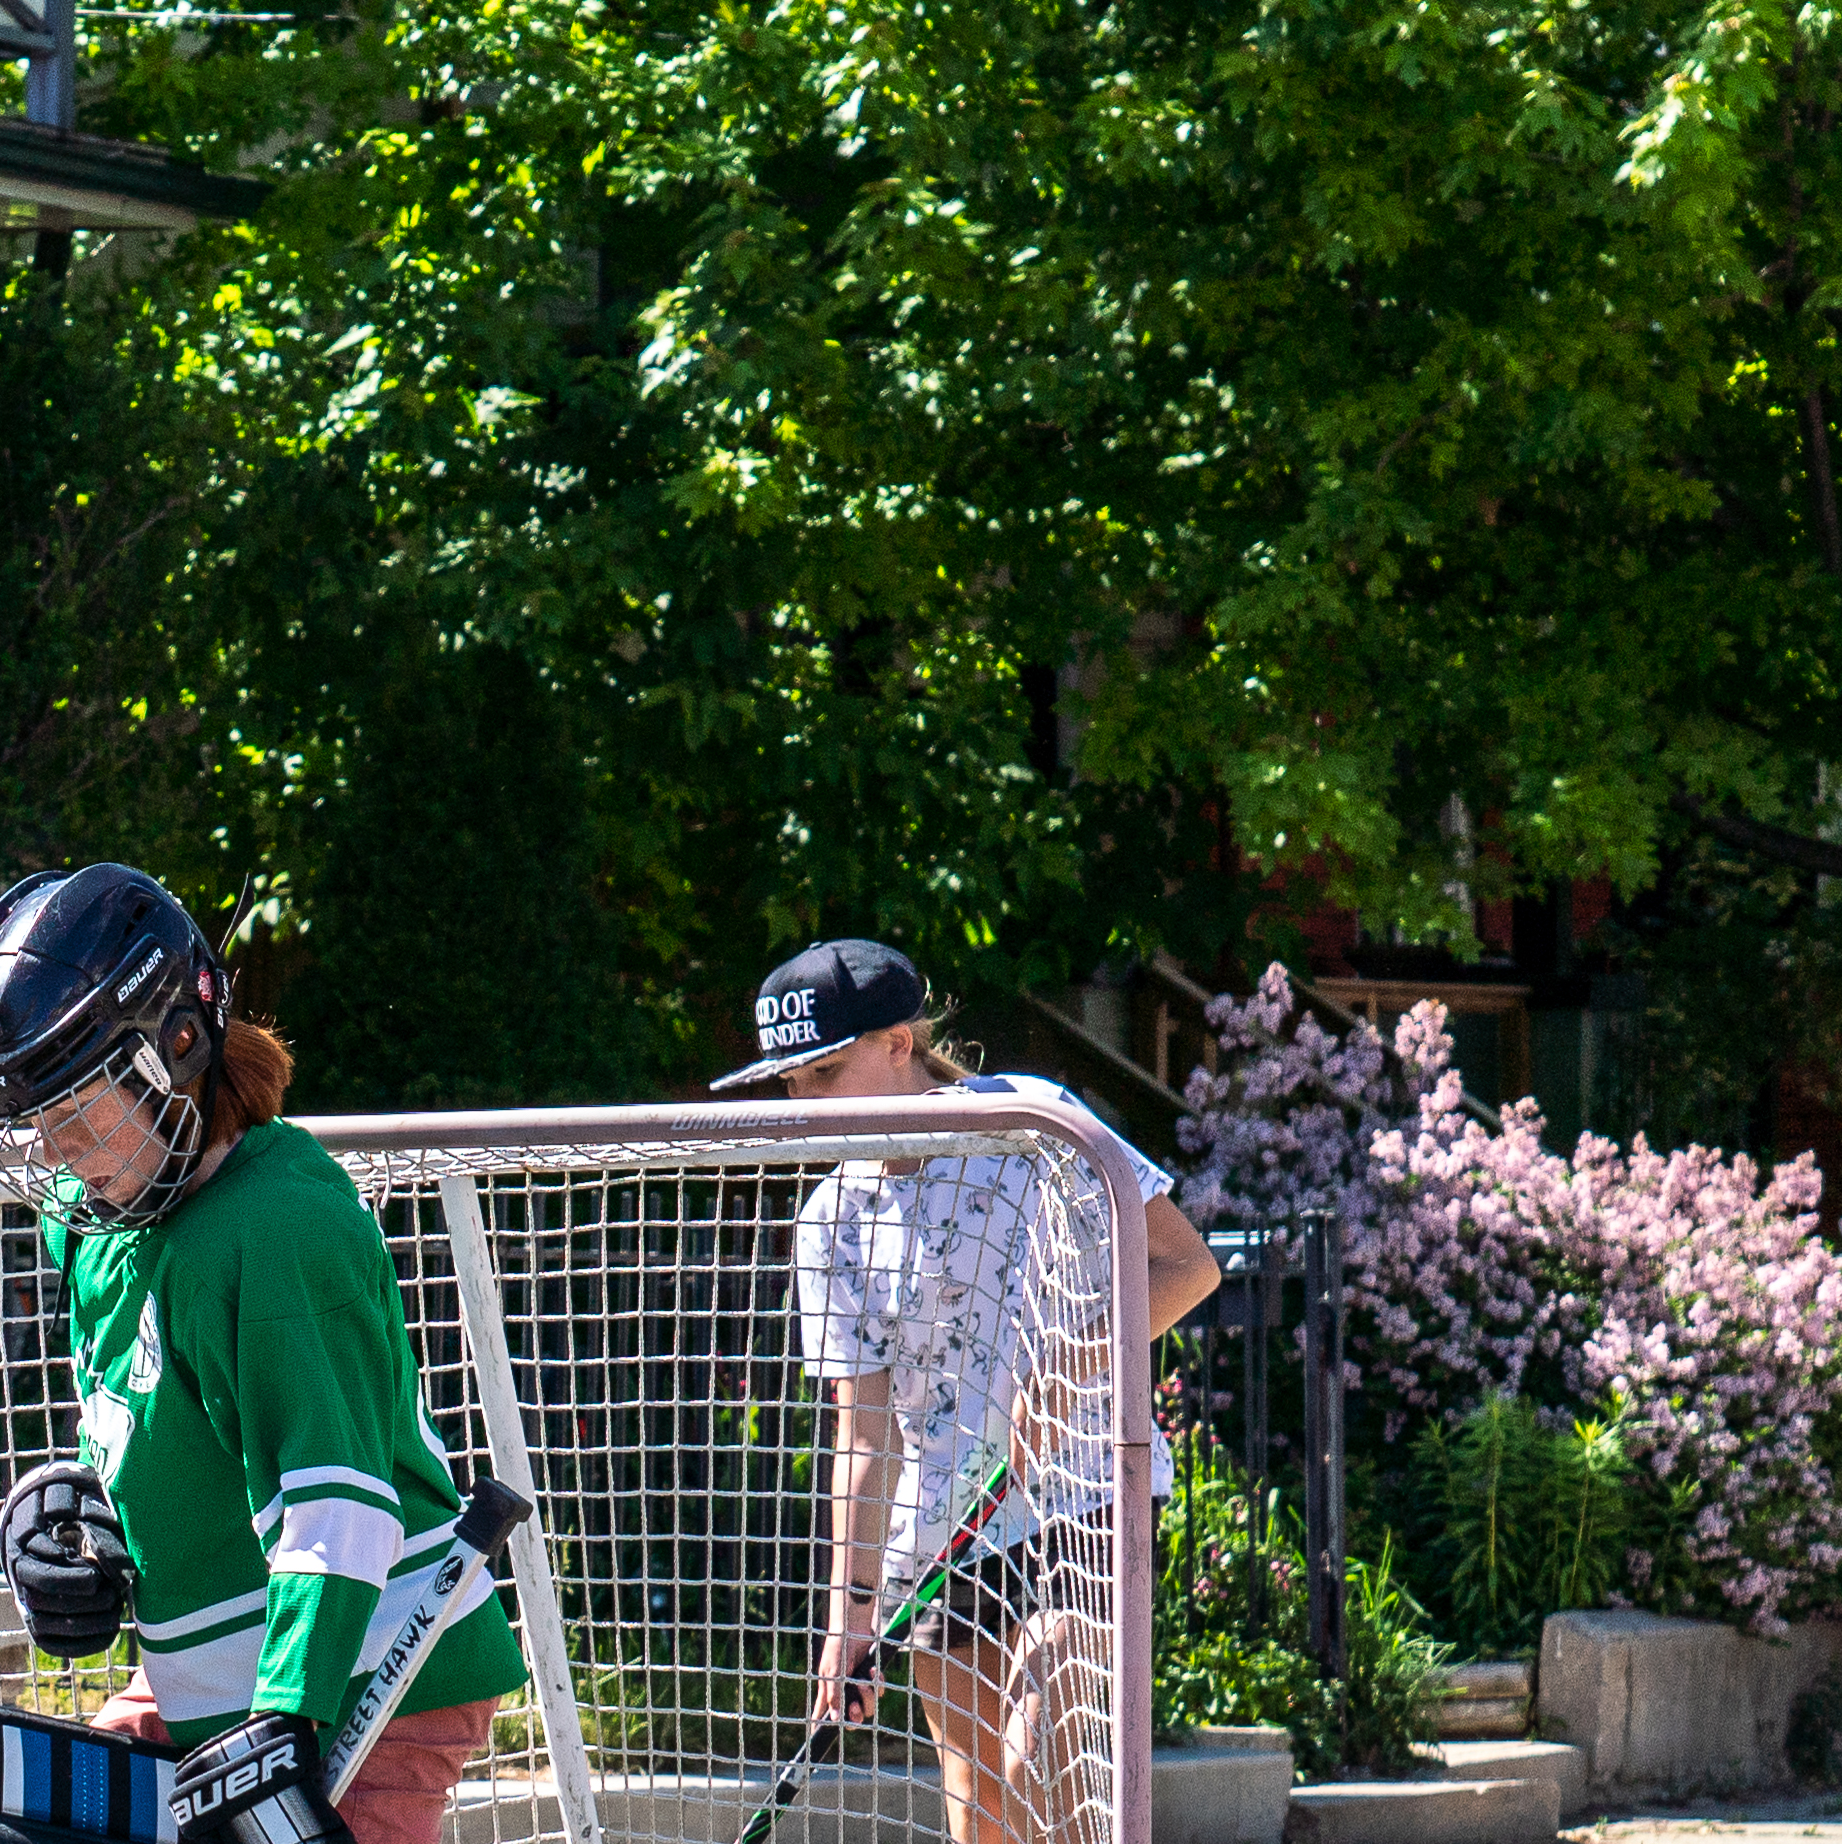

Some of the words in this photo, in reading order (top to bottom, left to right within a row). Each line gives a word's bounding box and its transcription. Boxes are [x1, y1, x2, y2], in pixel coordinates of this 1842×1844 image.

[118, 947, 164, 1003] BAUER
[782, 988, 815, 1020] OF
[325, 1688, 382, 1779] STREET
[379, 1604, 435, 1685] HAWK
[169, 1743, 299, 1826] AUER
